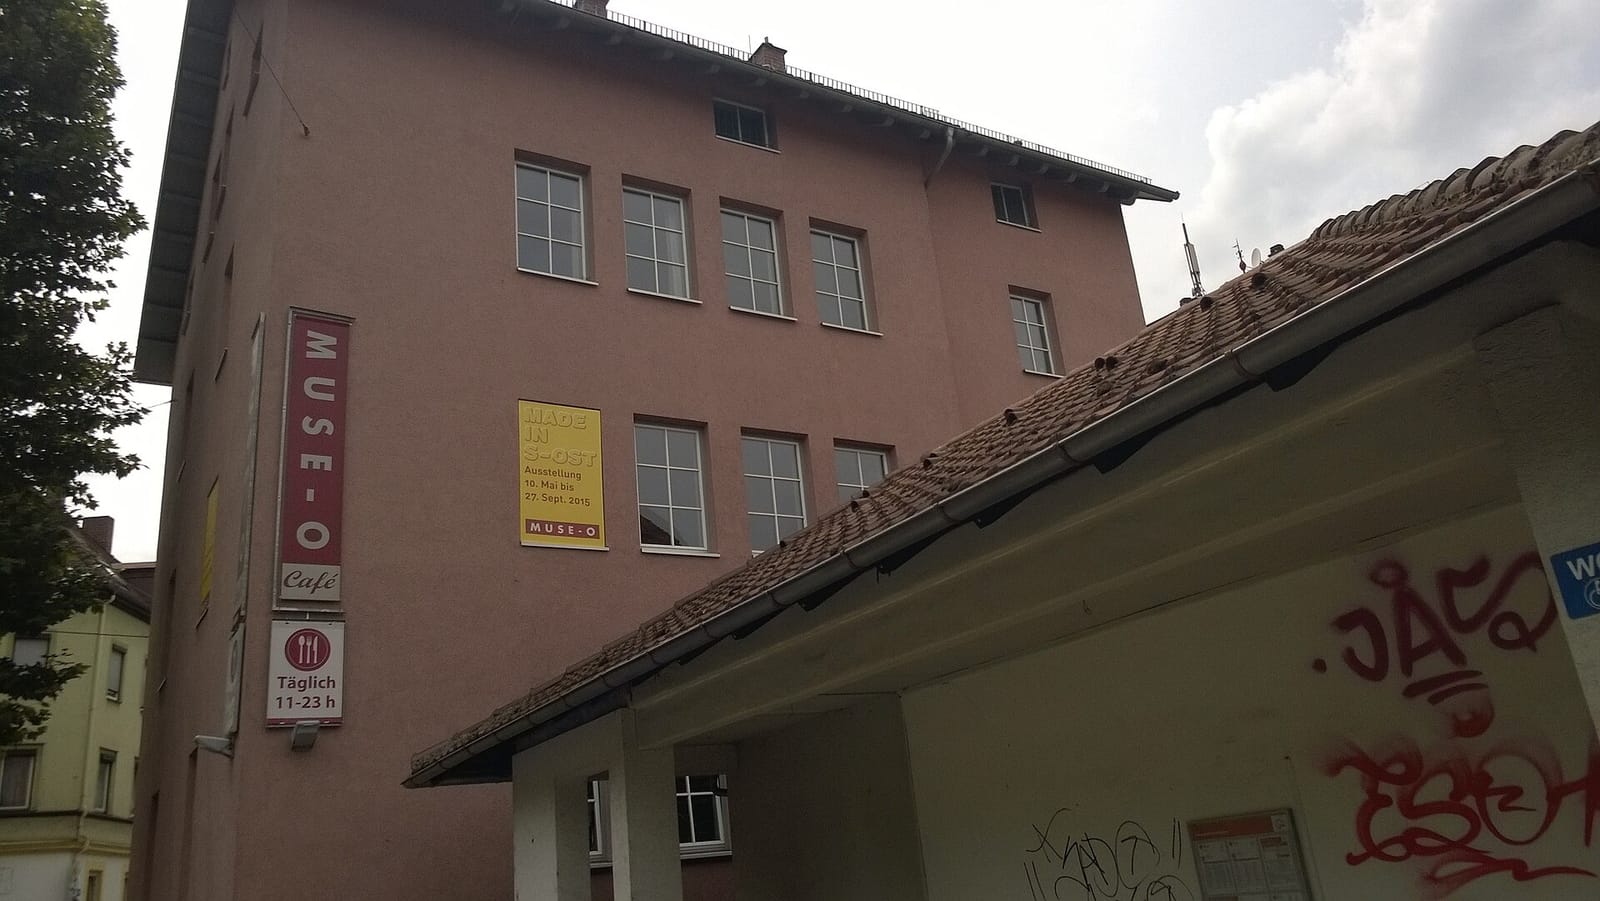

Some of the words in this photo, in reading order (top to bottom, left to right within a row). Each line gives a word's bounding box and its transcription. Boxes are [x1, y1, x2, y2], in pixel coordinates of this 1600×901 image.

[524, 407, 587, 430] MADE
[296, 331, 338, 551] MUSE-O
[525, 426, 549, 444] IN
[524, 444, 598, 468] S-OST
[524, 466, 582, 481] Ausstellung
[524, 479, 538, 488] 10.
[541, 480, 558, 490] Mai
[561, 481, 574, 491] bis
[525, 492, 539, 502] 27.
[541, 494, 567, 505] Sept.
[568, 496, 591, 507] 2015
[530, 522, 596, 537] MUSE-O
[283, 570, 338, 594] Café
[277, 676, 336, 693] Täglich
[276, 696, 321, 709] 11-23
[326, 695, 336, 709] h
